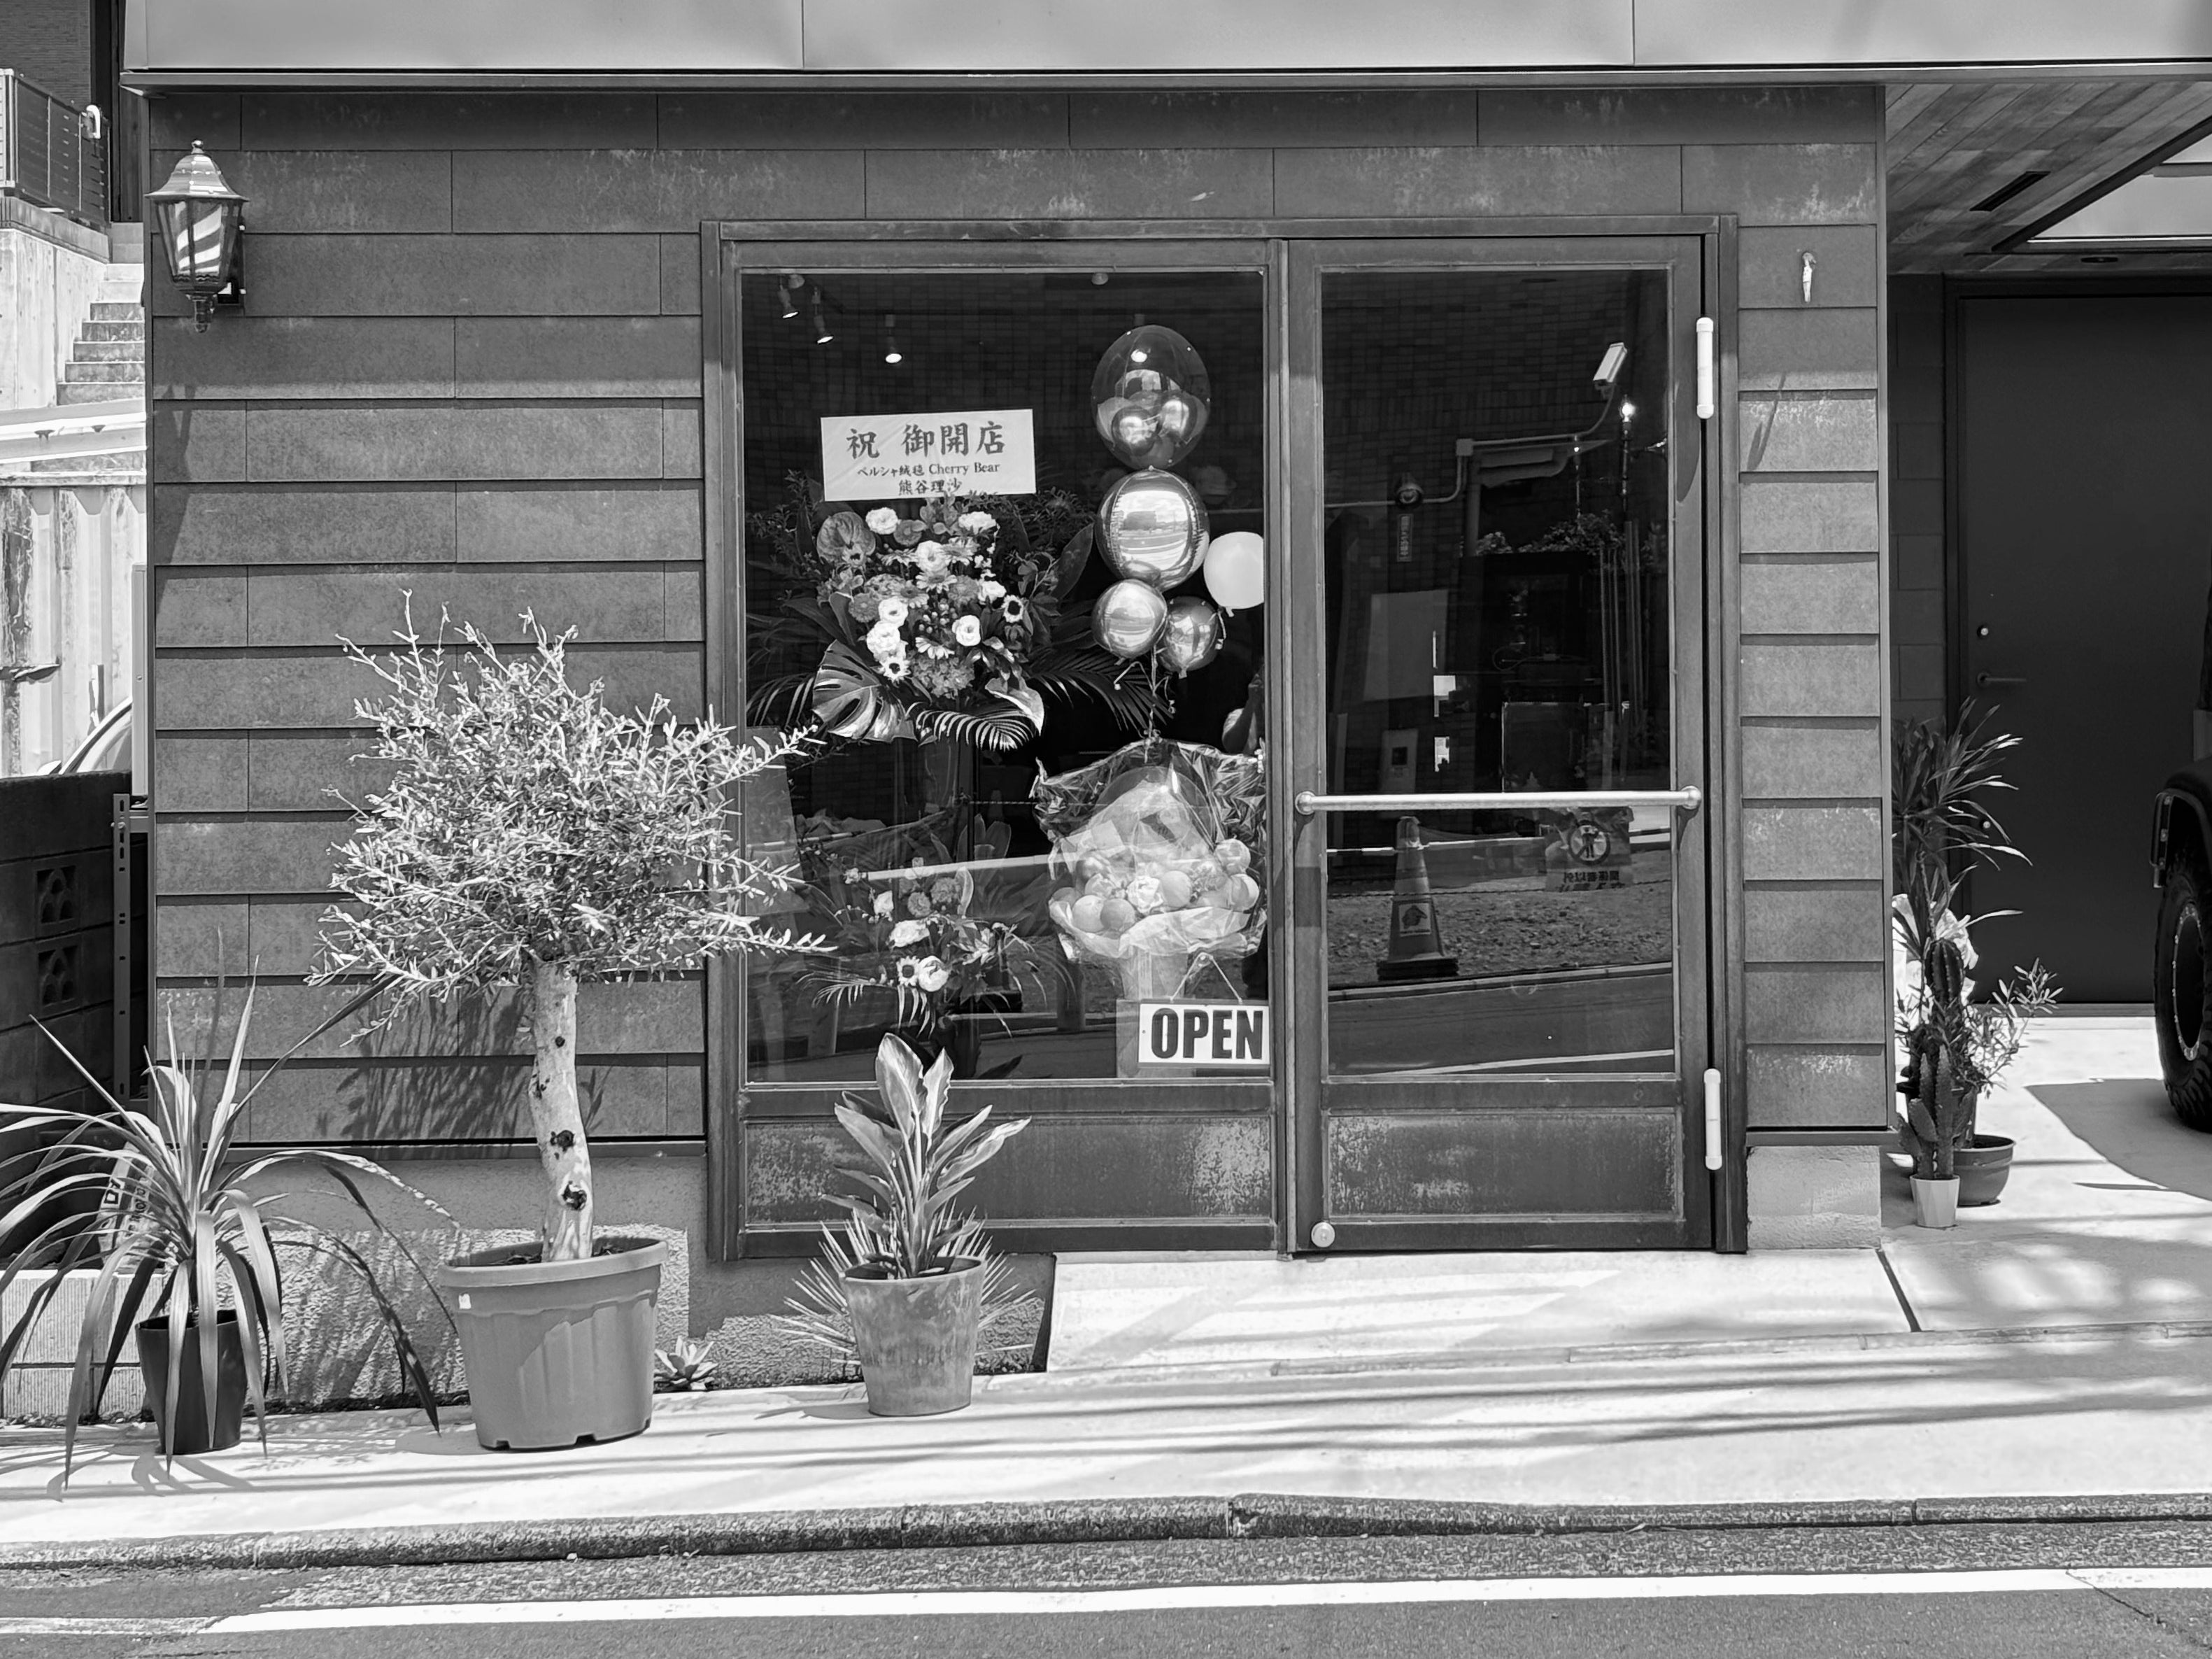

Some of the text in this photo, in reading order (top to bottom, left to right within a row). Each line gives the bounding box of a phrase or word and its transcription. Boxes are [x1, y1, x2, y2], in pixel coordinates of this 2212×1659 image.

[846, 421, 1005, 459] 祝 御開店
[928, 463, 970, 476] Cherry
[974, 462, 1000, 473] Bear
[1151, 1008, 1263, 1059] OPEN
